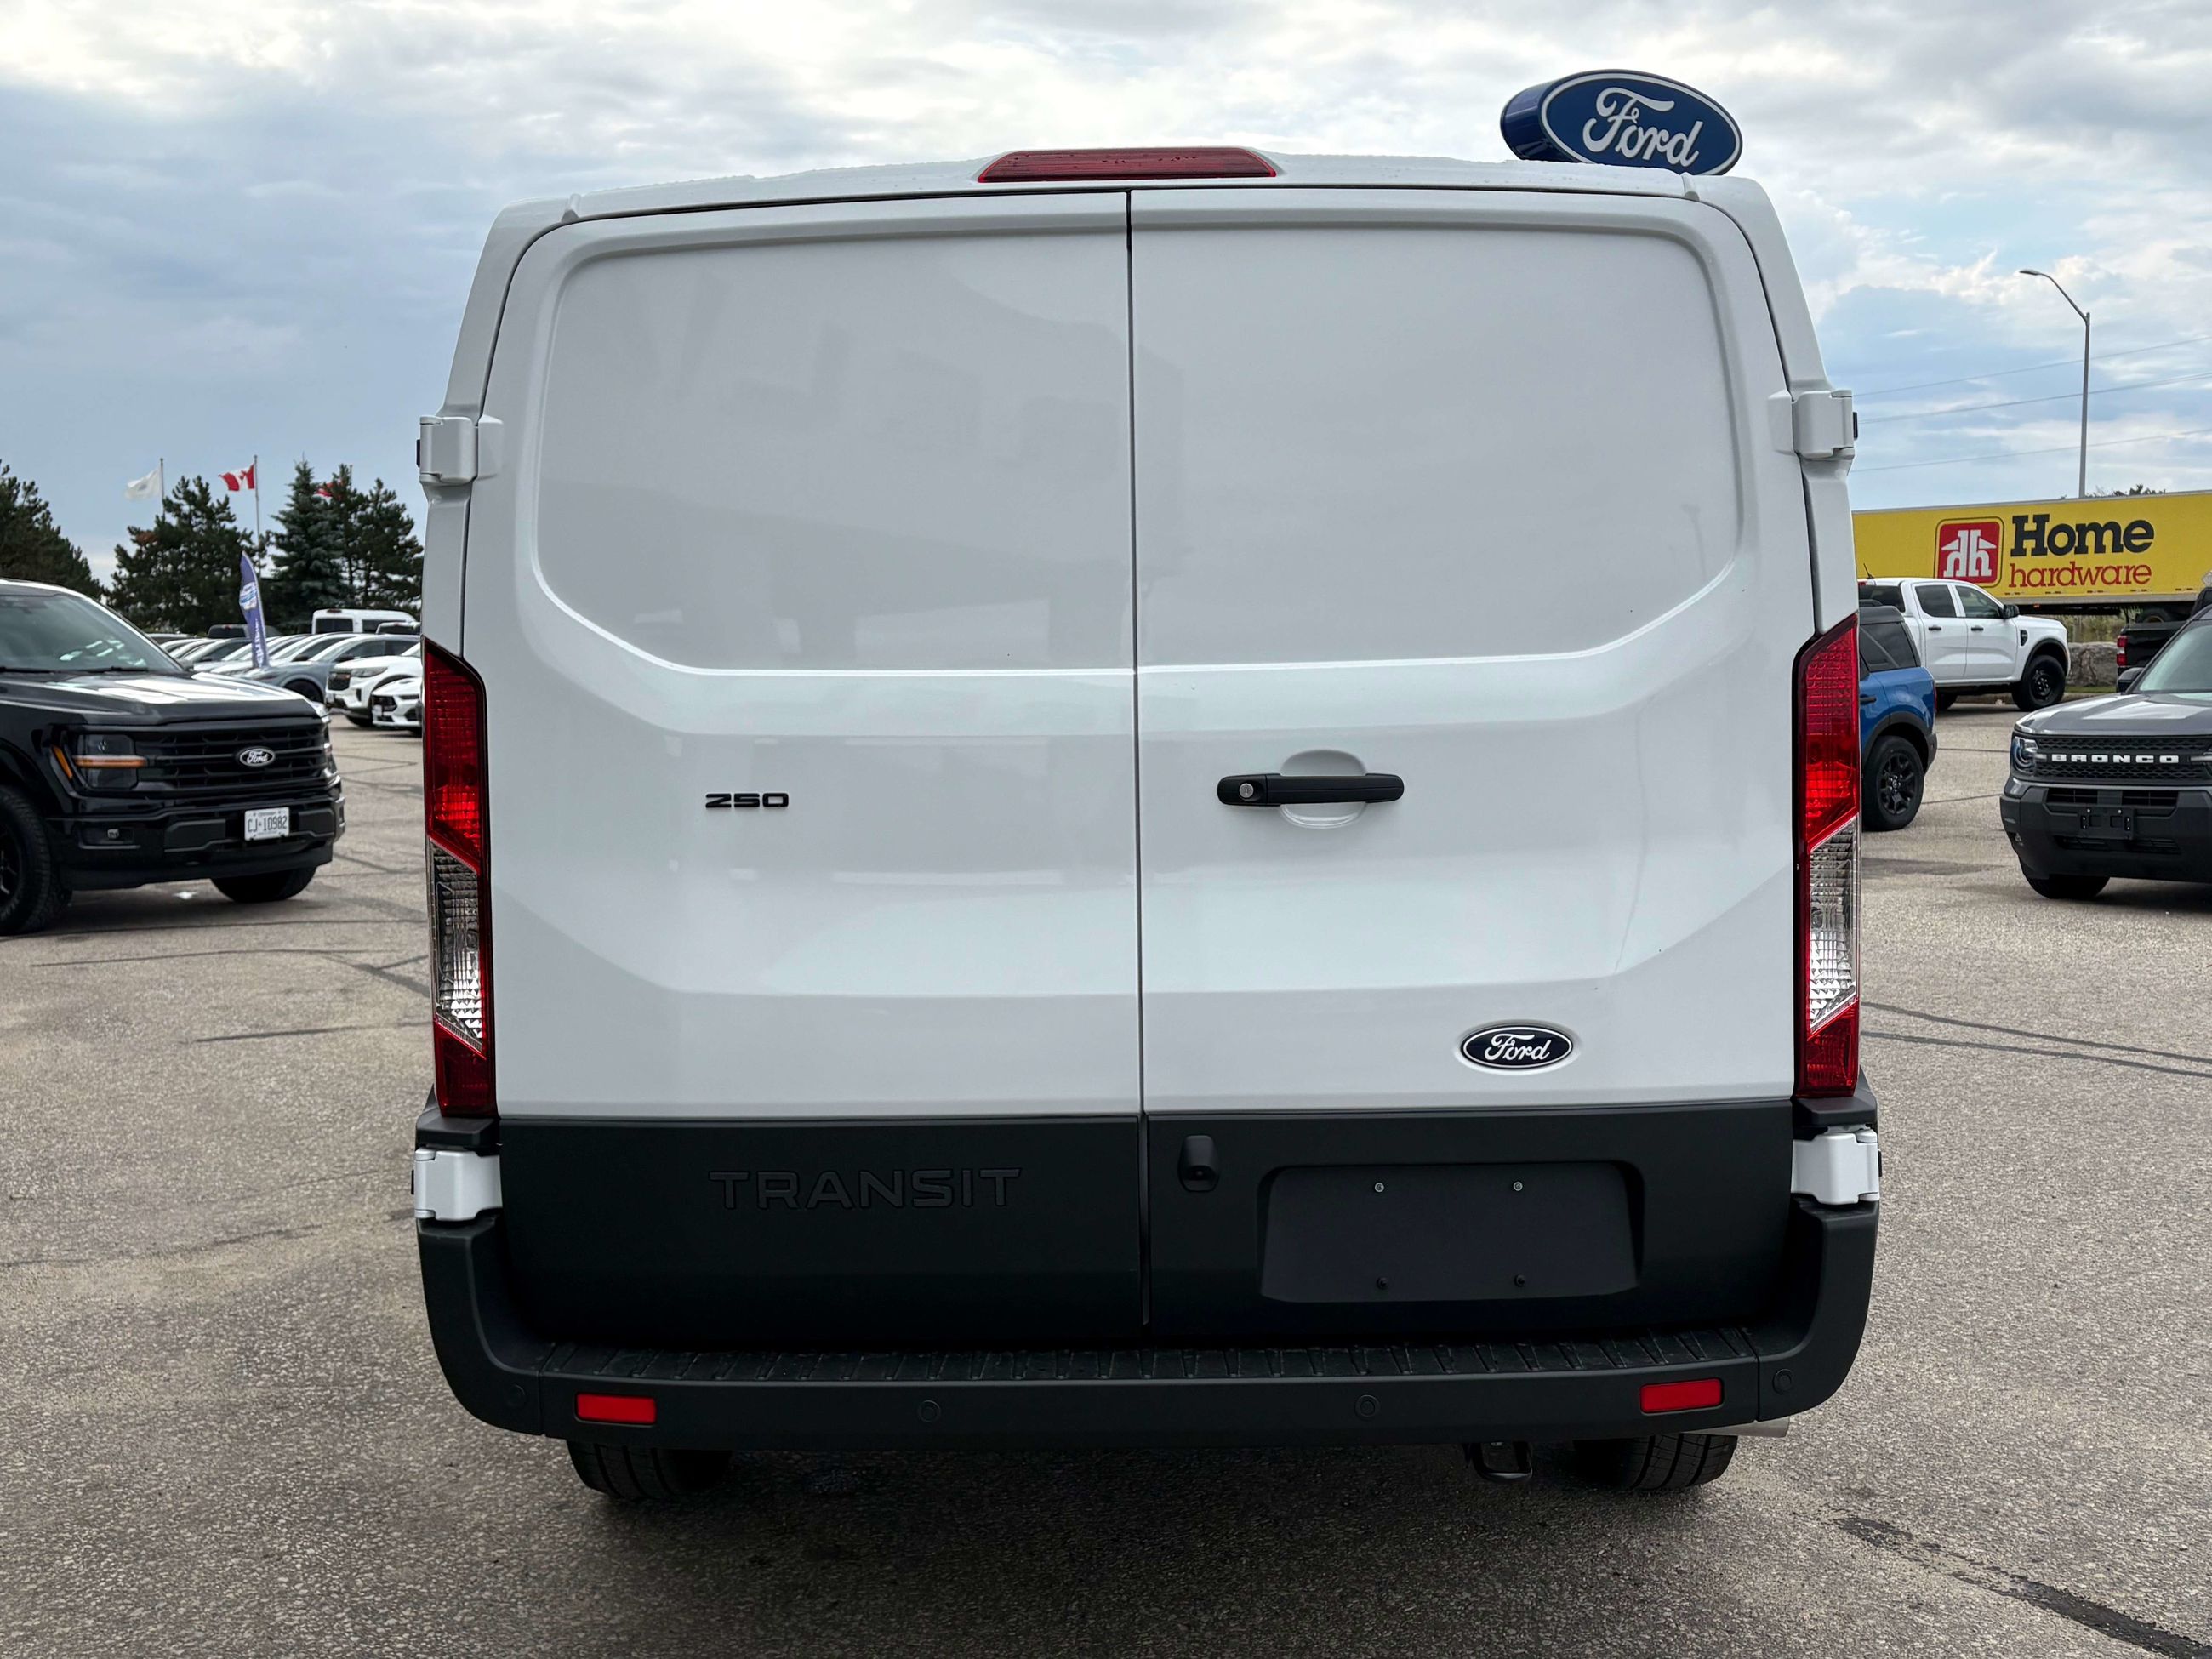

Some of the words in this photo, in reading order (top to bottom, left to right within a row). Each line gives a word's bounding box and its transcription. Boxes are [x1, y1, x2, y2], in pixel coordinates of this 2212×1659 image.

[1582, 87, 1704, 168] Ford
[2010, 513, 2155, 557] Home
[2009, 561, 2152, 588] hardware
[247, 750, 268, 764] Ford
[2051, 754, 2179, 763] BRONCO
[704, 792, 790, 808] 250
[1484, 1033, 1552, 1061] Ford
[708, 1168, 1022, 1210] TRANSIT
